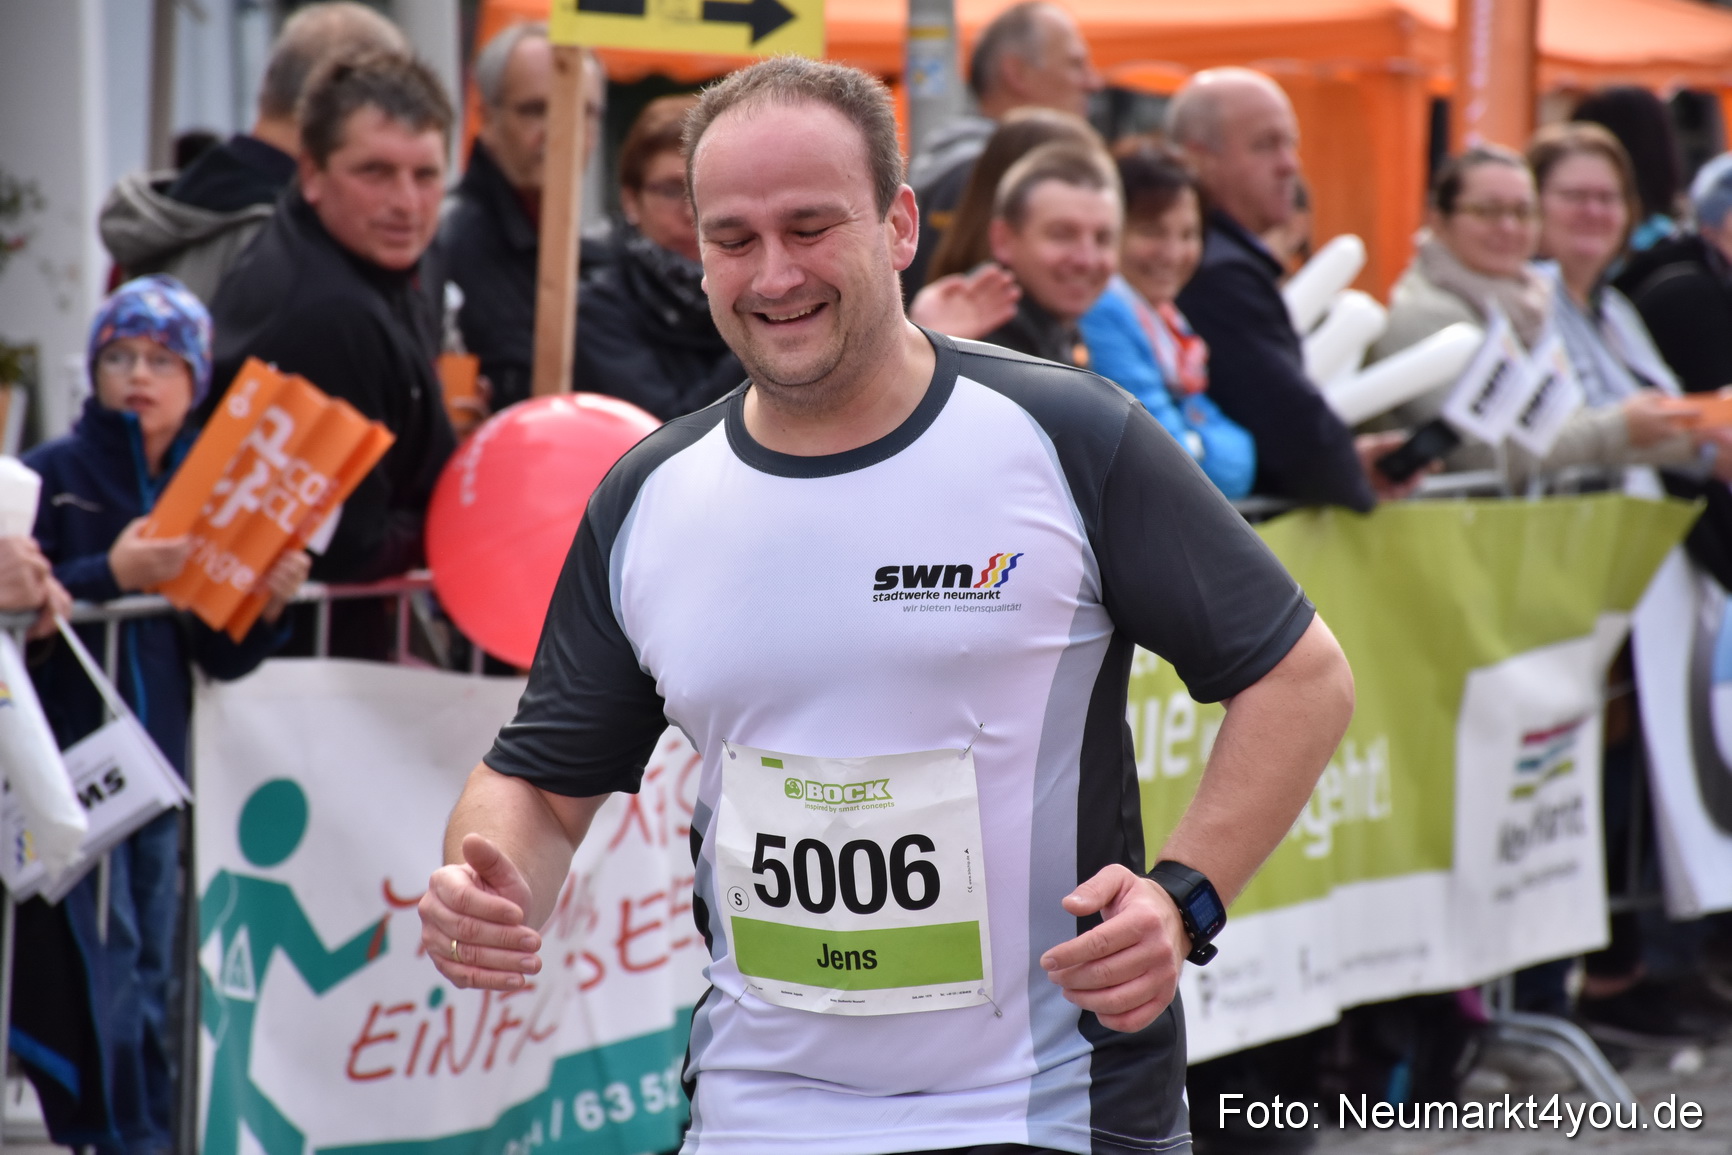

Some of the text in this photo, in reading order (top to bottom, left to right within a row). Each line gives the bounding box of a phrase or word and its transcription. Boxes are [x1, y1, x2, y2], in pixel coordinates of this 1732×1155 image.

[873, 563, 974, 591] swn
[872, 590, 1001, 602] stadtwerke neumarkt
[902, 603, 1022, 613] wir bieten lebensqualität!
[805, 778, 893, 805] BOCK
[804, 801, 895, 814] inspired by smart concepts
[752, 832, 941, 915] 5006
[734, 892, 743, 906] S
[816, 943, 878, 971] Jens
[573, 1081, 636, 1132] 63
